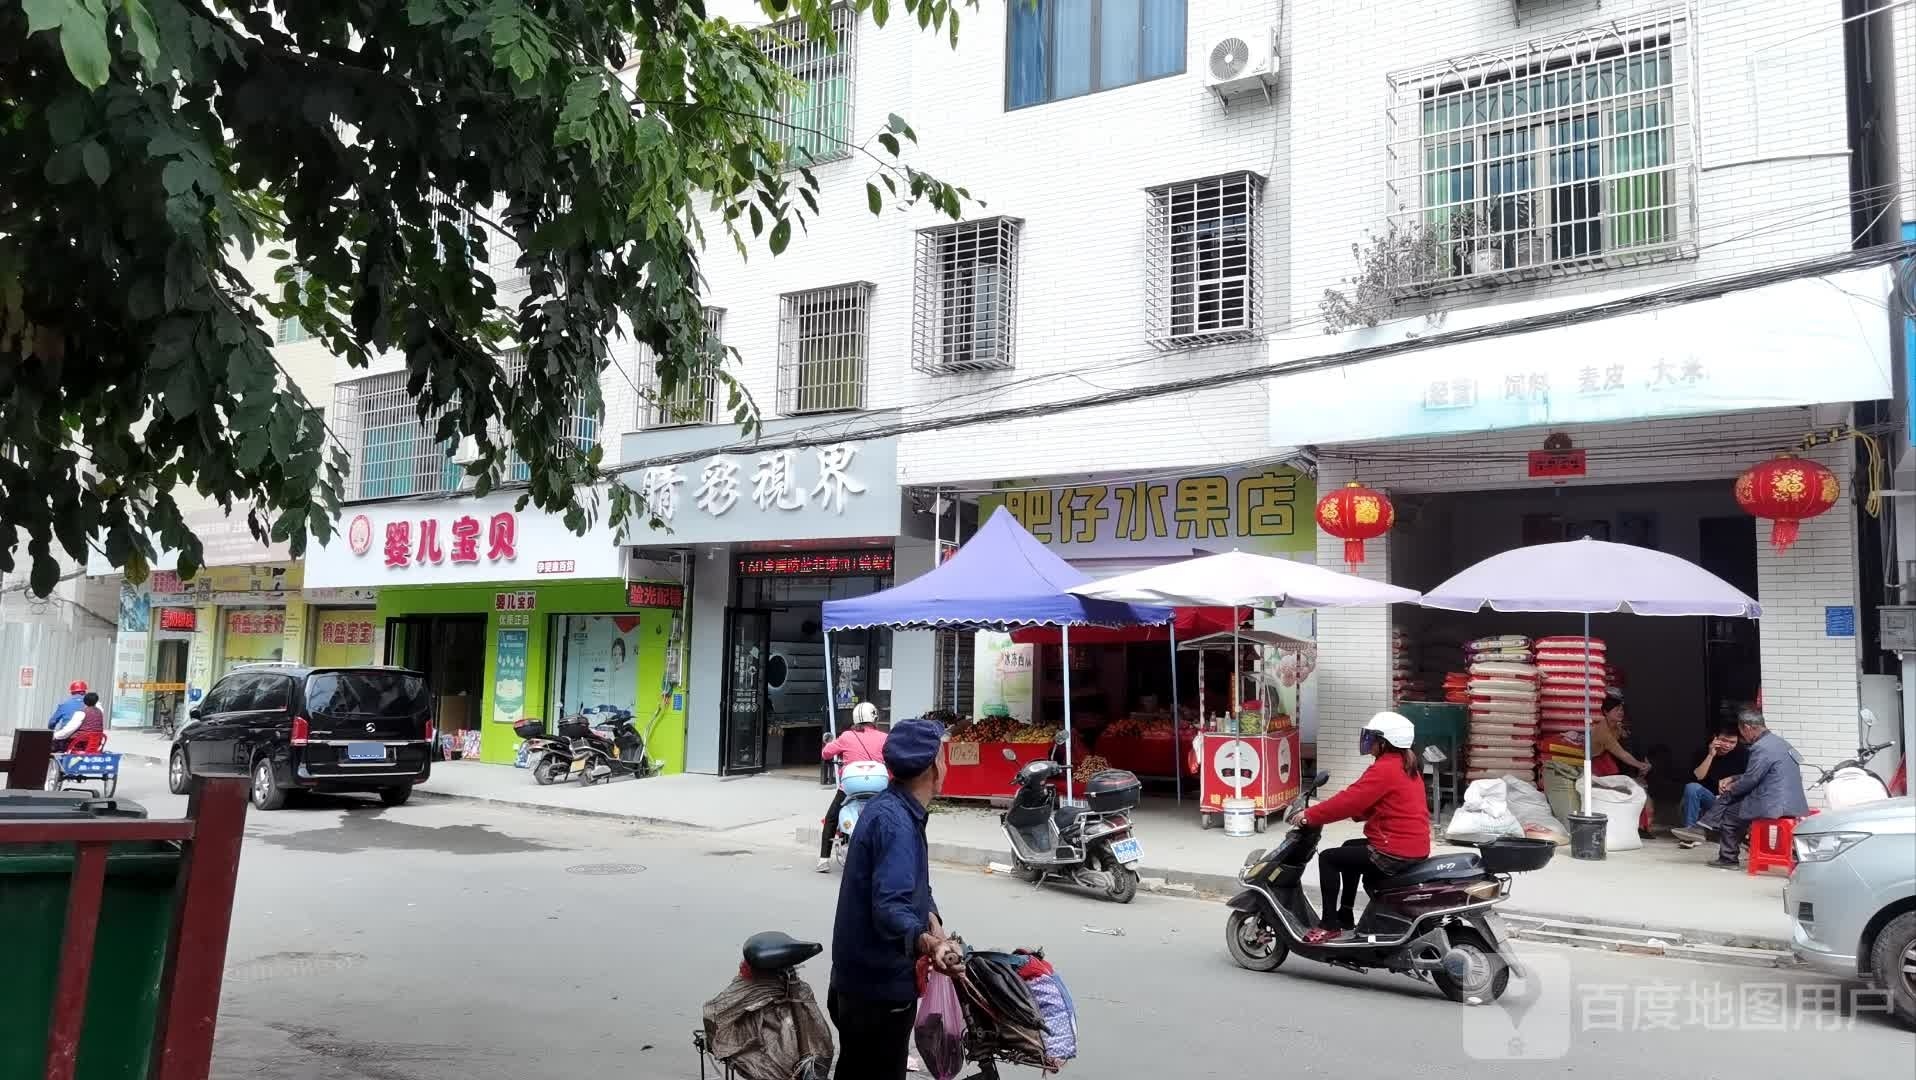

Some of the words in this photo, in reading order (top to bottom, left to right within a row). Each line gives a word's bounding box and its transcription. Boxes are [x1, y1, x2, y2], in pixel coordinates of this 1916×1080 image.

[1578, 363, 1625, 394] 麦皮
[1651, 354, 1705, 386] 大米
[1003, 472, 1296, 544] 肥仔水果店
[383, 511, 517, 568] 婴儿宝贝
[495, 594, 536, 610] 婴儿宝贝
